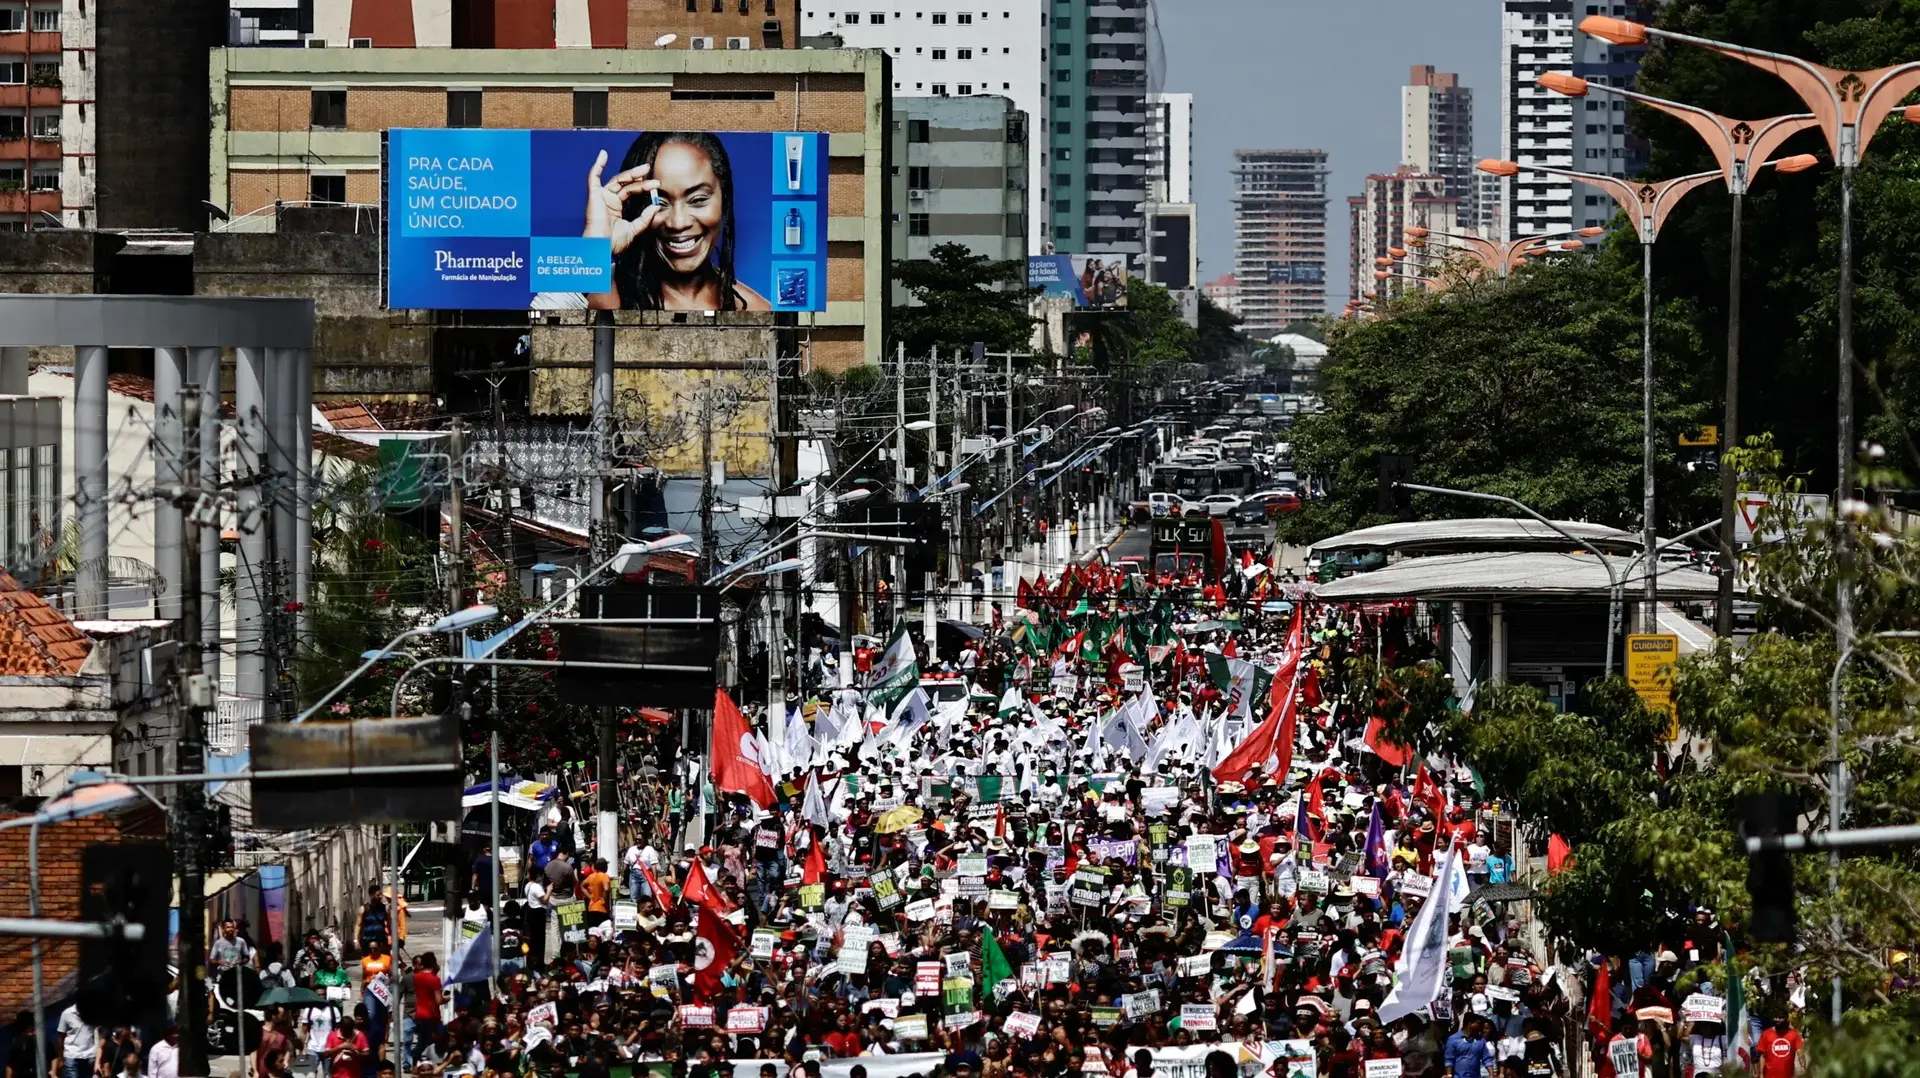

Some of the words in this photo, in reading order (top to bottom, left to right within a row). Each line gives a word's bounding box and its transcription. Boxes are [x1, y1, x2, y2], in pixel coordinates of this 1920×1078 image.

[409, 157, 443, 171] PRA
[447, 157, 494, 171] CADA
[408, 173, 467, 191] SAÚDE,
[408, 196, 435, 209] UM
[440, 196, 517, 209] CUIDADO
[408, 211, 465, 228] ÚNICO.
[434, 250, 524, 273] Pharmapele
[537, 256, 545, 264] A
[546, 256, 584, 264] BELEZA
[1035, 261, 1056, 270] plano
[537, 266, 551, 275] DE
[552, 266, 570, 275] SER
[441, 273, 469, 281] Farmácia
[478, 274, 517, 282] Manipulação
[1633, 642, 1672, 650] CUIDADO!
